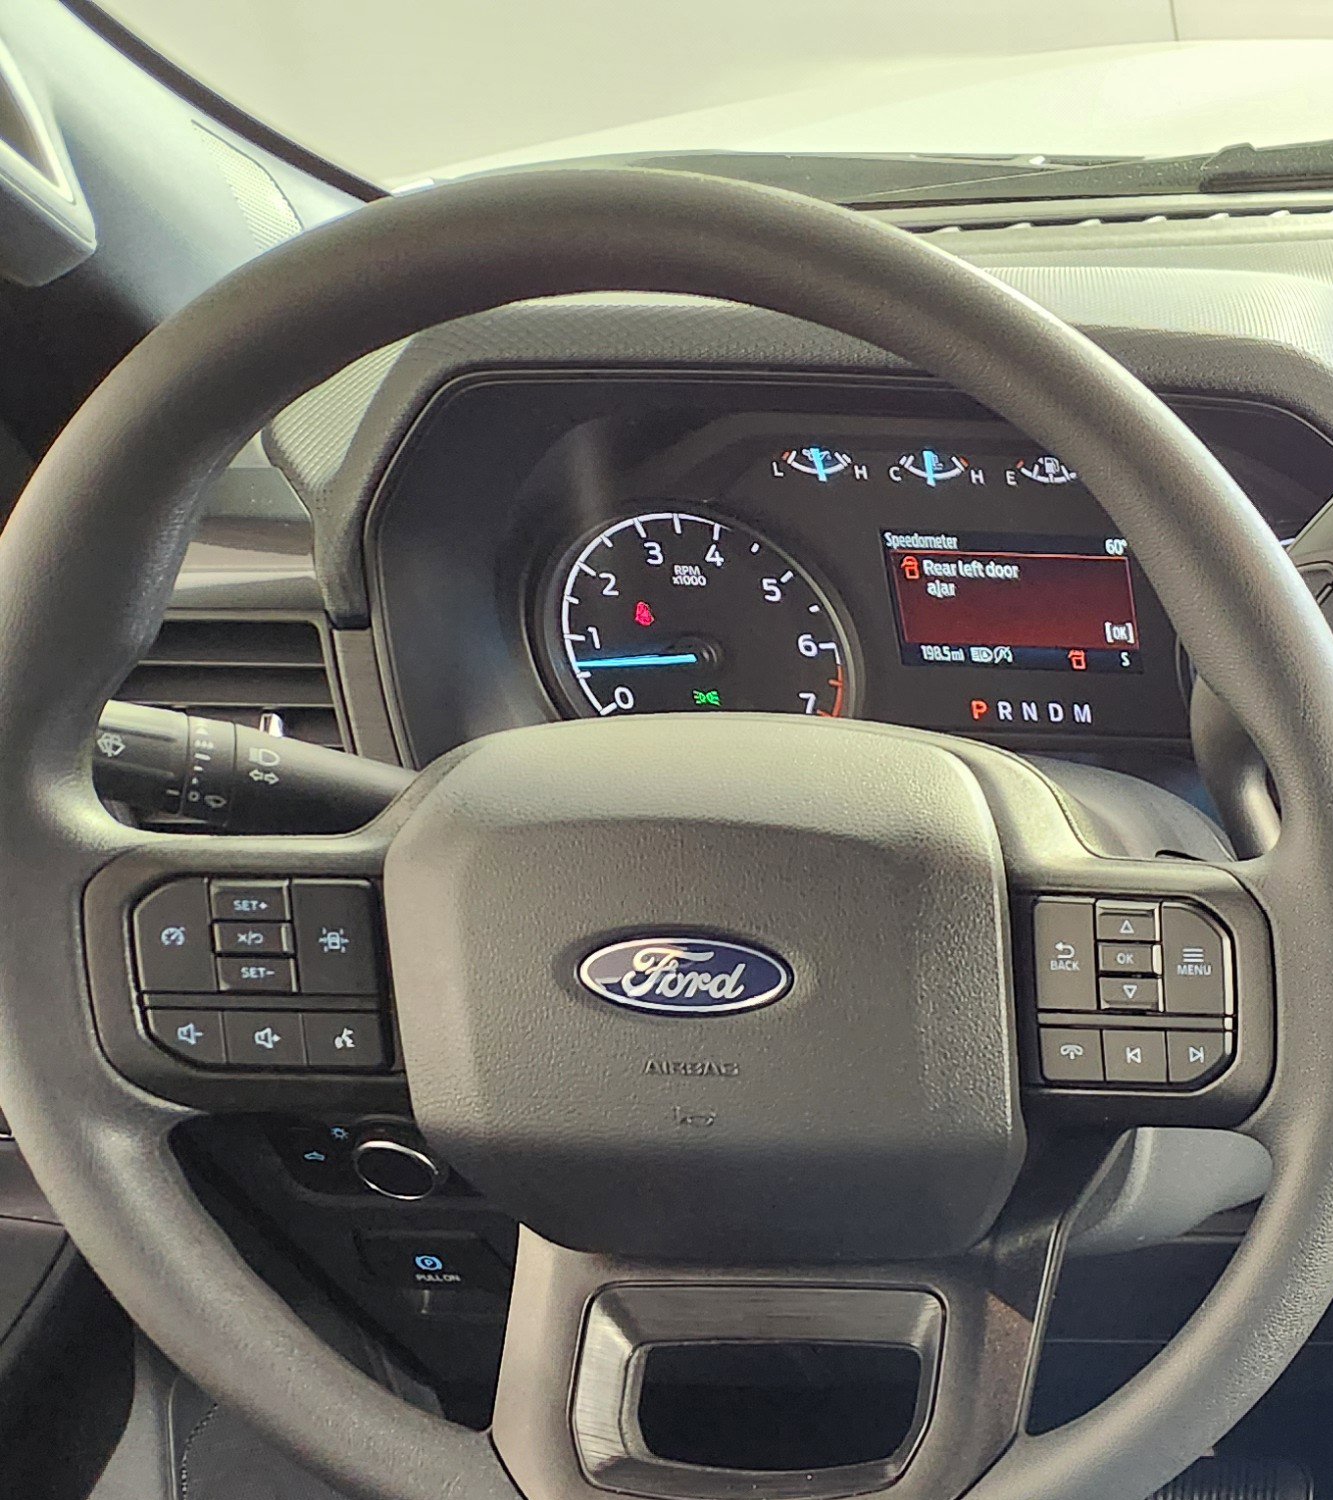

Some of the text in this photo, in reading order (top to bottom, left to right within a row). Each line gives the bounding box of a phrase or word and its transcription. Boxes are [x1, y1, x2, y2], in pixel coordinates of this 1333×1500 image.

[772, 461, 868, 480] L H
[889, 466, 985, 485] C H
[1005, 470, 1018, 486] E
[884, 532, 958, 550] Speedometer
[644, 542, 664, 565] 3
[705, 544, 724, 567] 4
[674, 565, 701, 575] RPM
[923, 560, 1020, 579] Rear left door
[599, 573, 620, 596] 2
[762, 578, 782, 602] 5
[927, 580, 956, 598] ajar
[587, 626, 601, 649] 1
[798, 633, 819, 657] 6
[614, 686, 634, 710] 0
[799, 692, 816, 714] 7
[971, 700, 1092, 723] P R N D M
[1050, 959, 1080, 971] BACK
[1116, 952, 1134, 964] OK
[597, 945, 747, 1000] Ford
[1177, 964, 1211, 976] MENU
[643, 1059, 740, 1077] AIRBAG
